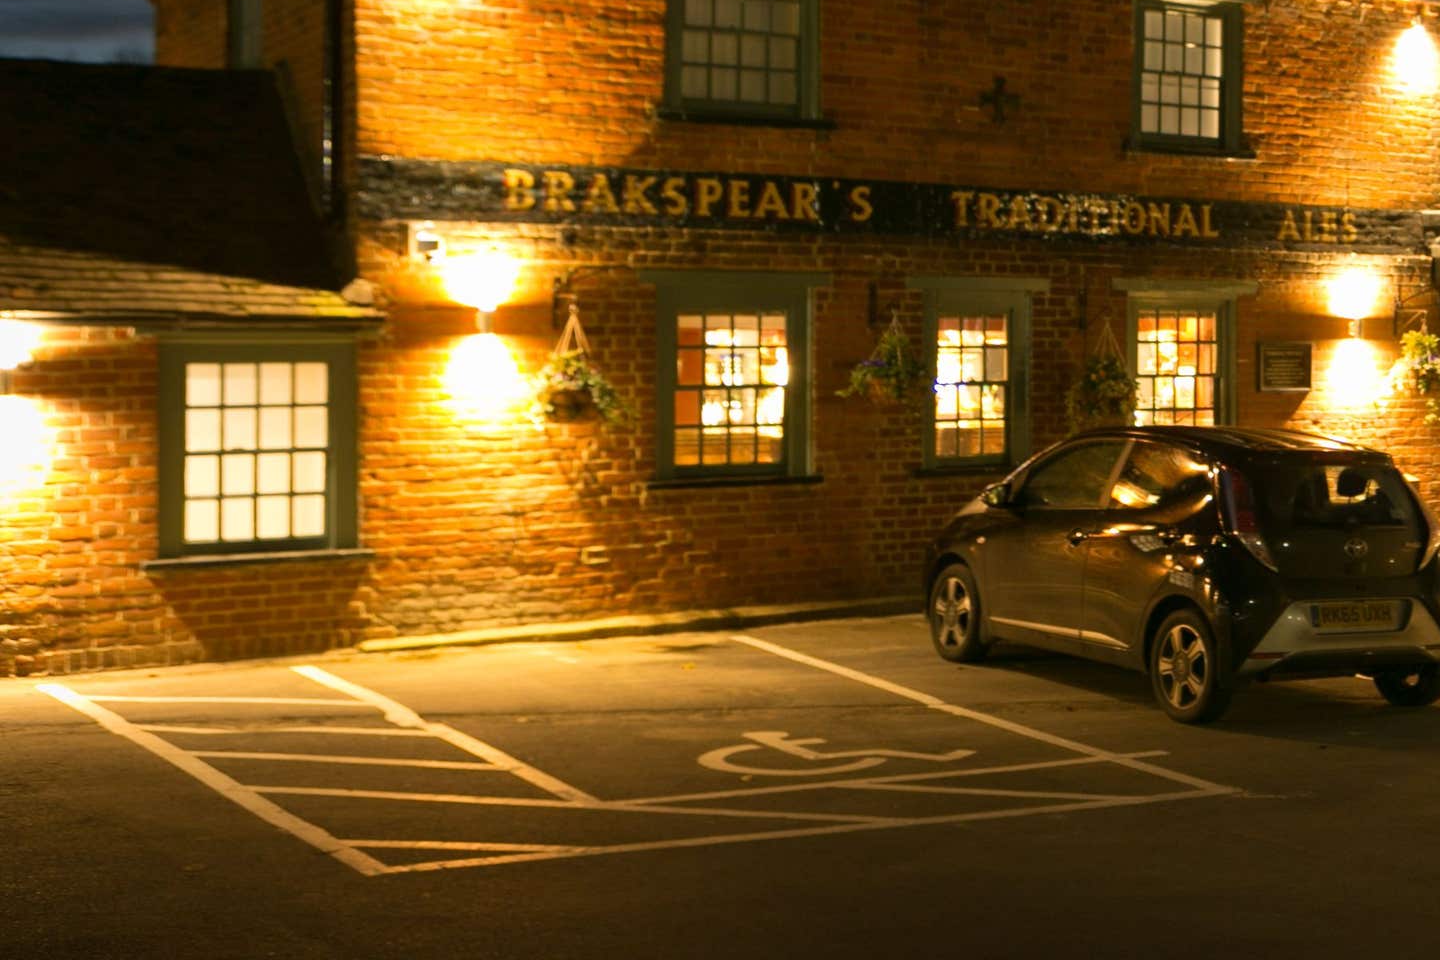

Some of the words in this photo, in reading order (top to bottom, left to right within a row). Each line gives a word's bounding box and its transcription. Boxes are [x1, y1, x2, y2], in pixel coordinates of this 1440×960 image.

[503, 166, 874, 223] BRAKSPEAR'S
[951, 190, 1220, 239] TRADITIONAL
[1276, 208, 1358, 243] ALES
